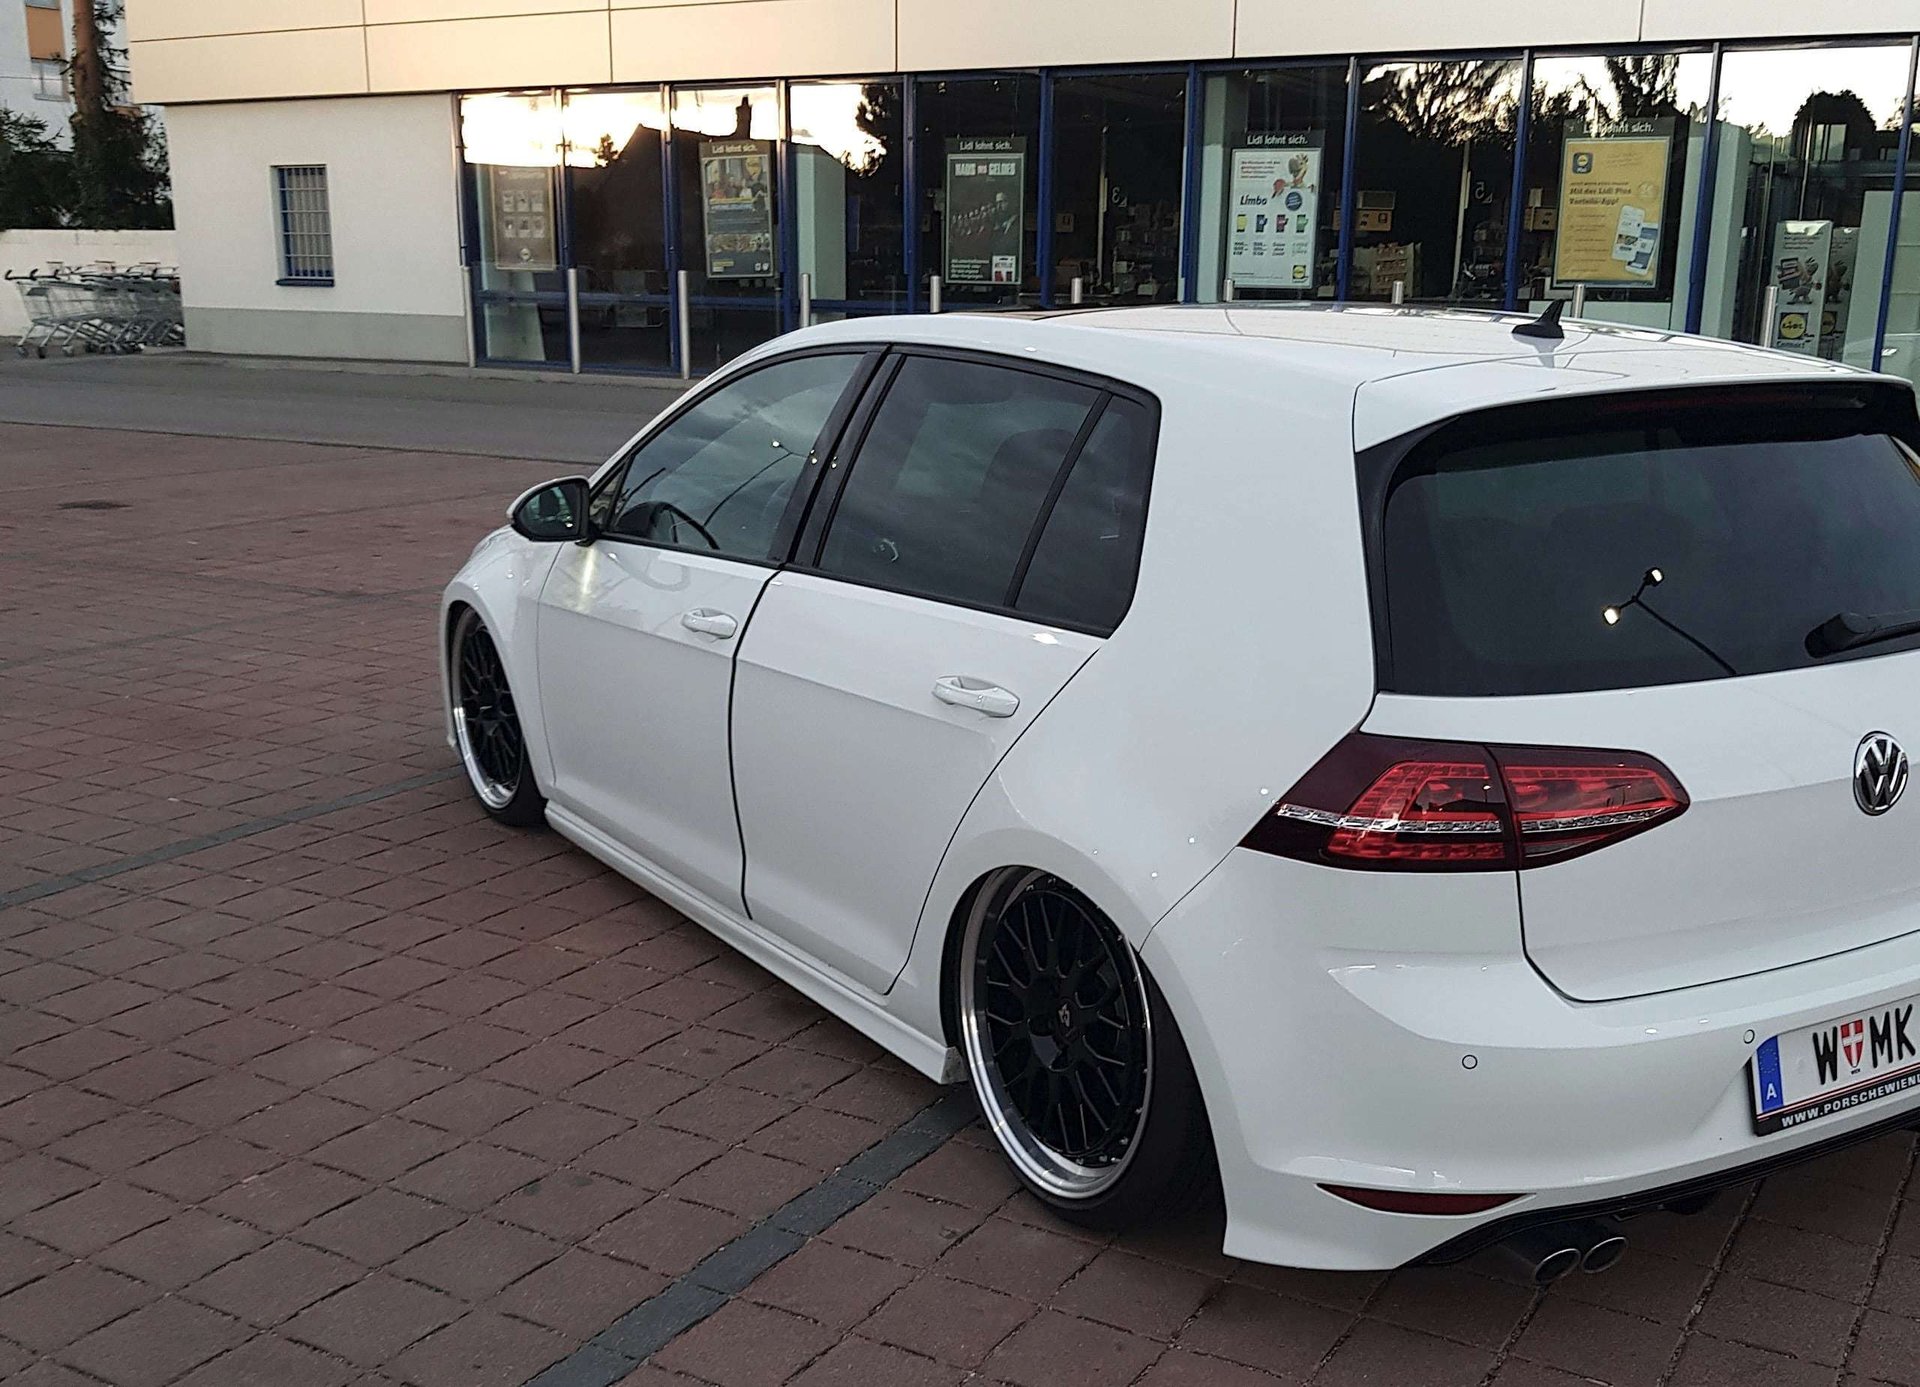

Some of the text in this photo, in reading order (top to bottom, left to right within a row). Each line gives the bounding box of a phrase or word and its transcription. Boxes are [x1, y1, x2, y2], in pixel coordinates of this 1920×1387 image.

[1247, 134, 1308, 145] Lidl lohnt sich.
[712, 145, 725, 154] Lidl
[959, 140, 1013, 151] Lidl lohnt sich.
[1240, 194, 1267, 206] Limbo
[1812, 1003, 1917, 1086] W MK
[1766, 1082, 1778, 1101] A
